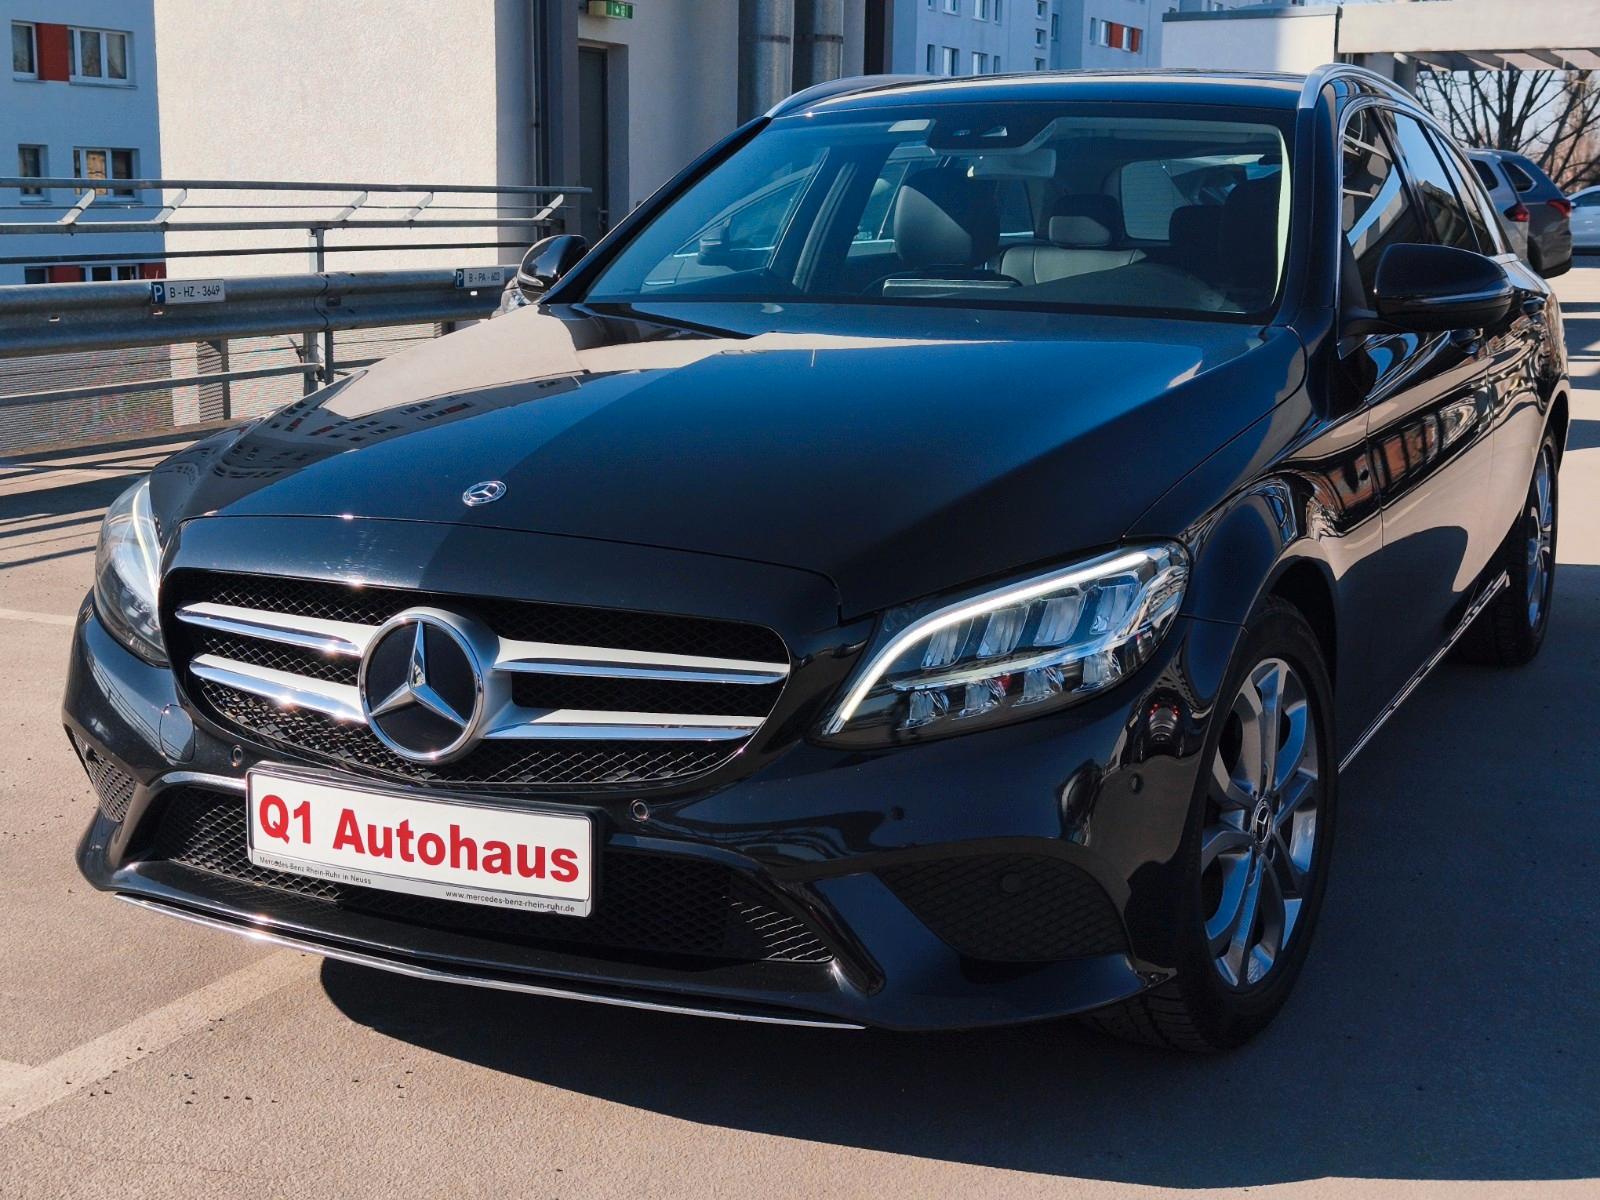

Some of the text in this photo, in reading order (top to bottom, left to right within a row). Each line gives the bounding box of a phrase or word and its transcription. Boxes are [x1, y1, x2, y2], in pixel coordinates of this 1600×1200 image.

[153, 284, 163, 302] P
[169, 287, 176, 298] B
[184, 286, 195, 297] HZ
[202, 285, 220, 297] 3649
[259, 794, 580, 883] Q1 Autohaus
[306, 866, 341, 879] Rhein-Ruhr
[342, 872, 349, 880] in
[350, 874, 372, 885] Neuss
[445, 890, 575, 913] www.mercedes-benz-rhein-ruhr.de
